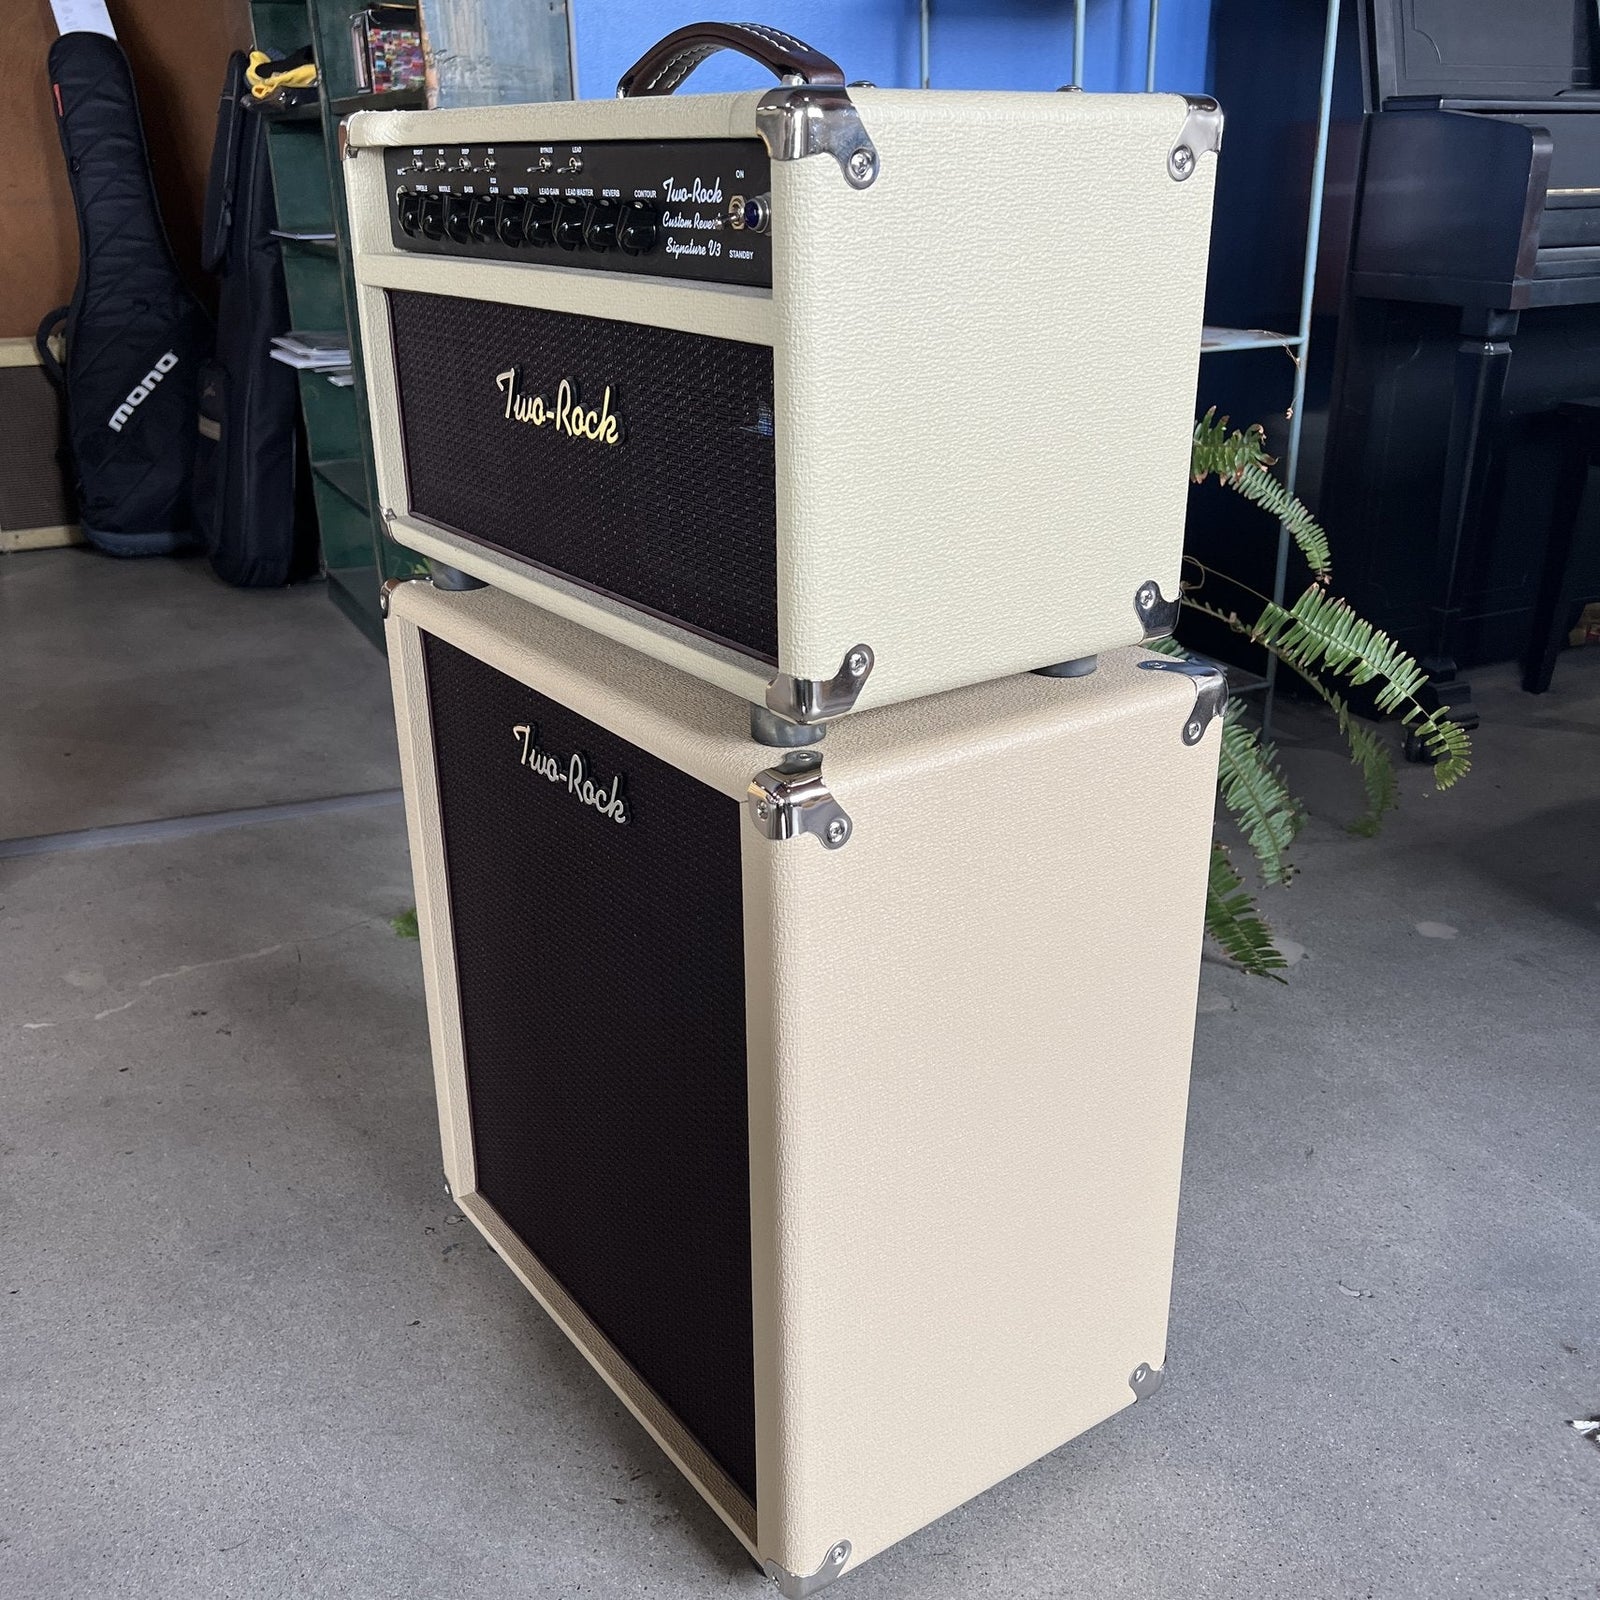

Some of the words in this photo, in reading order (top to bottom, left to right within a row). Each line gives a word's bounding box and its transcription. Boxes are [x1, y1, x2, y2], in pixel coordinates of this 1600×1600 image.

[735, 169, 745, 179] ON
[489, 186, 499, 194] GAIN
[513, 186, 529, 195] MASTER
[538, 187, 550, 196] LEAD
[549, 187, 560, 196] GAIN
[564, 187, 576, 196] LEAD
[576, 188, 594, 197] MASTER
[602, 188, 621, 198] REVERB
[633, 189, 657, 199] CONTOUR
[662, 176, 723, 204] Two-Rock
[662, 210, 692, 229] Custom
[665, 236, 707, 260] Signature
[707, 239, 722, 257] V3
[728, 249, 754, 260] STANDBY
[108, 351, 179, 433] mono
[496, 367, 619, 444] Two-Rock
[512, 725, 626, 823] Two-Rock
